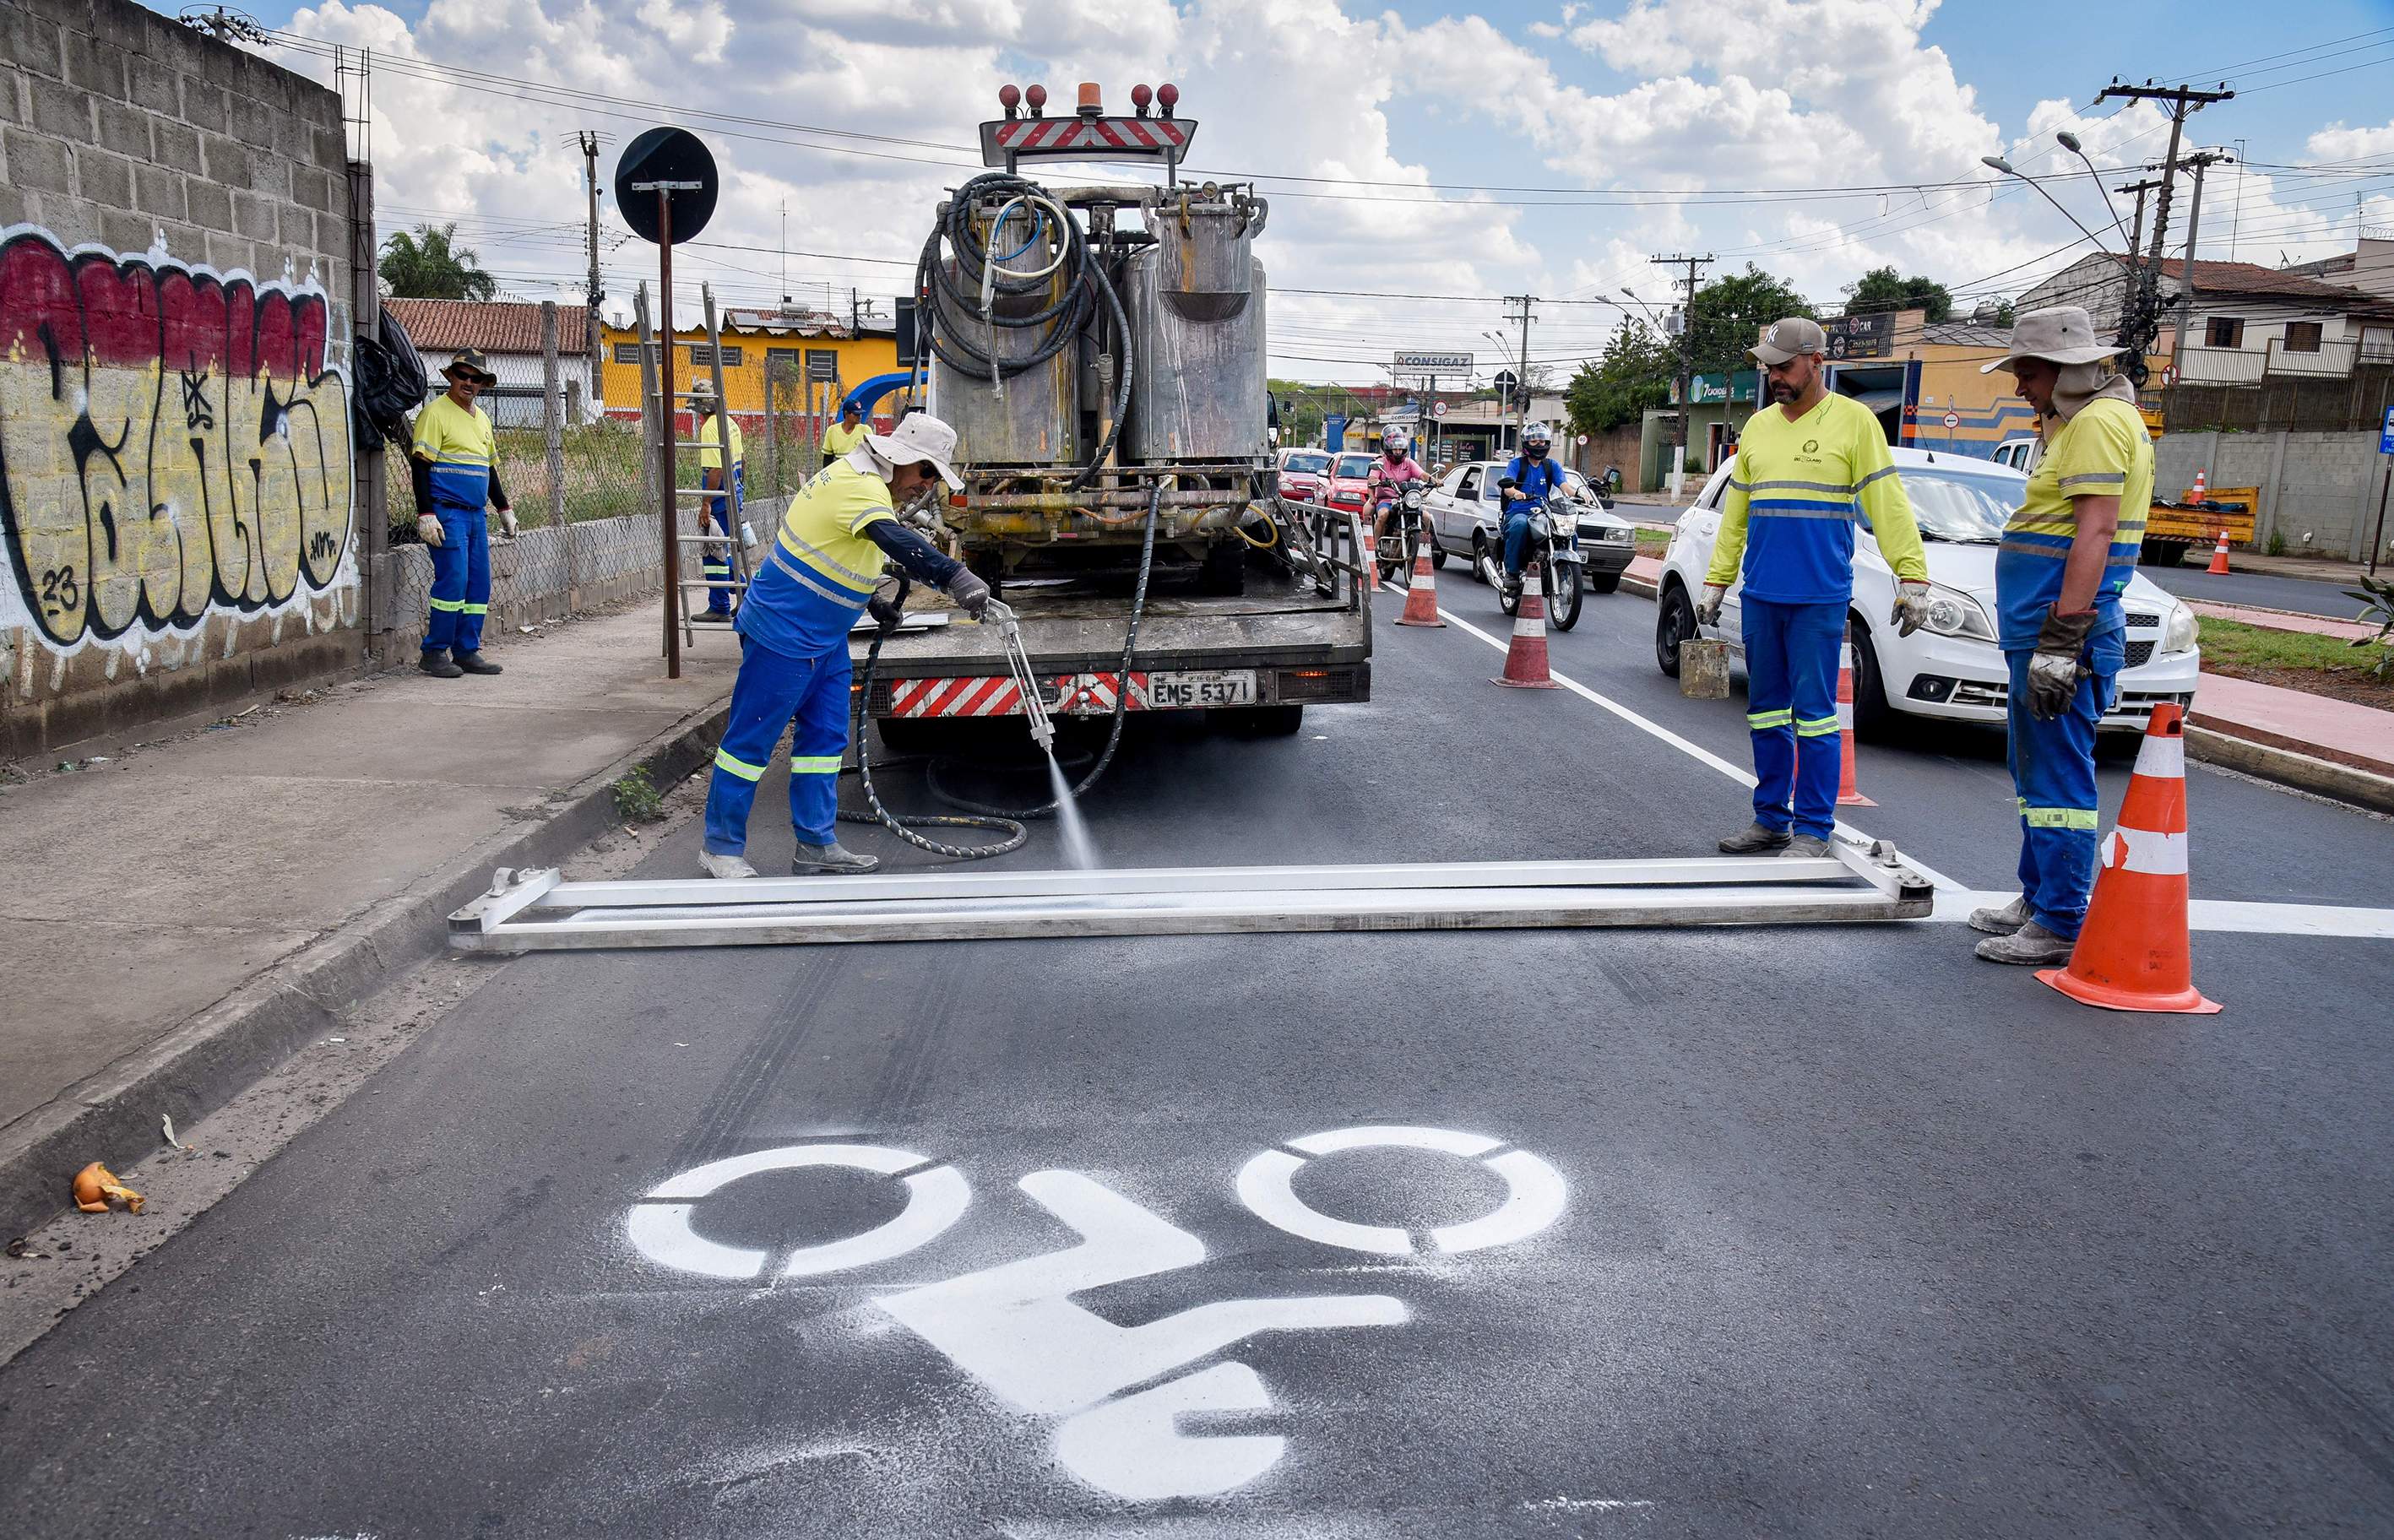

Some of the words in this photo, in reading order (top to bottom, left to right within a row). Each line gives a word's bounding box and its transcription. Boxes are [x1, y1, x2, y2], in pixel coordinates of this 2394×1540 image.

[1405, 356, 1468, 366] CONSIGAZ
[1154, 684, 1192, 703] EMS
[1200, 682, 1247, 702] 5371
